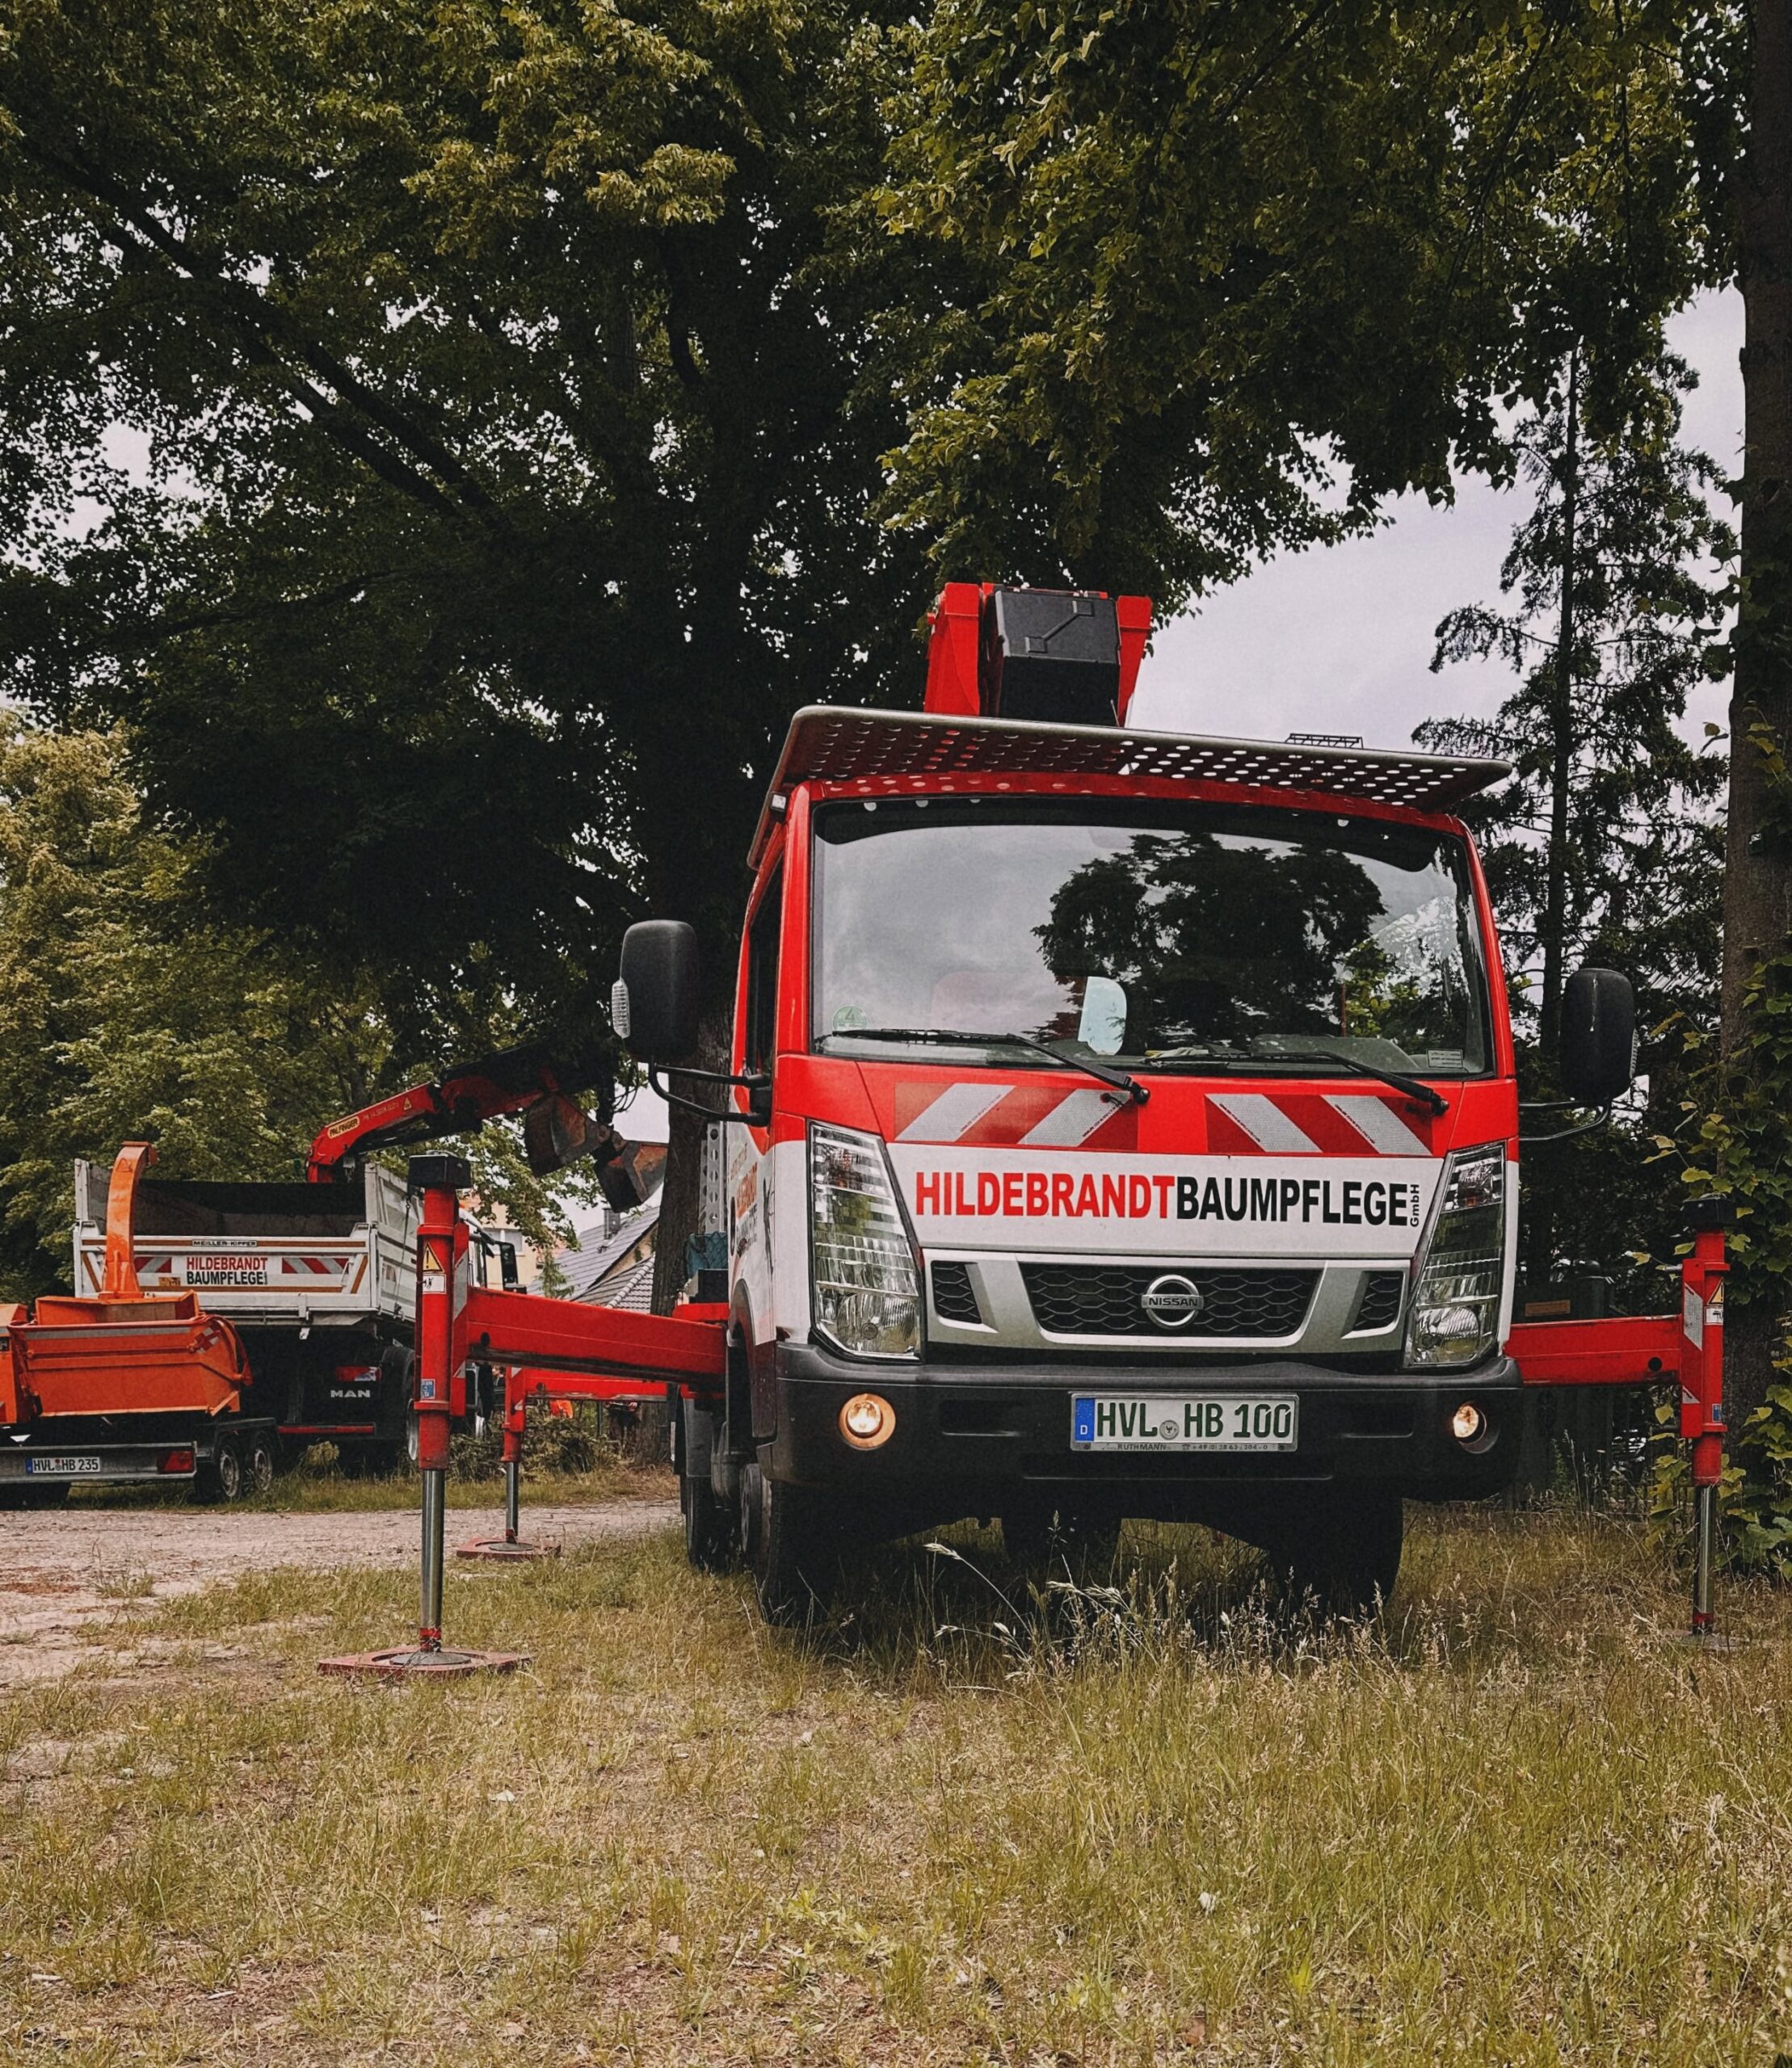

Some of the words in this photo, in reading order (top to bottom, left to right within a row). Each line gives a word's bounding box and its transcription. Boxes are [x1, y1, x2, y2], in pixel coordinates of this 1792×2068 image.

[1410, 1184, 1420, 1227] GmbH
[187, 1257, 268, 1271] HILDEBRANDT
[187, 1271, 265, 1284] BAUMPFLEGE
[1149, 1297, 1198, 1306] NISSAN
[330, 1389, 371, 1398] MAN
[1097, 1402, 1158, 1437] HVL
[1184, 1403, 1223, 1438] HB
[1234, 1404, 1291, 1438] 100
[1079, 1425, 1088, 1435] D
[33, 1459, 55, 1471] HVL
[61, 1459, 76, 1471] HB
[78, 1459, 99, 1471] 235
